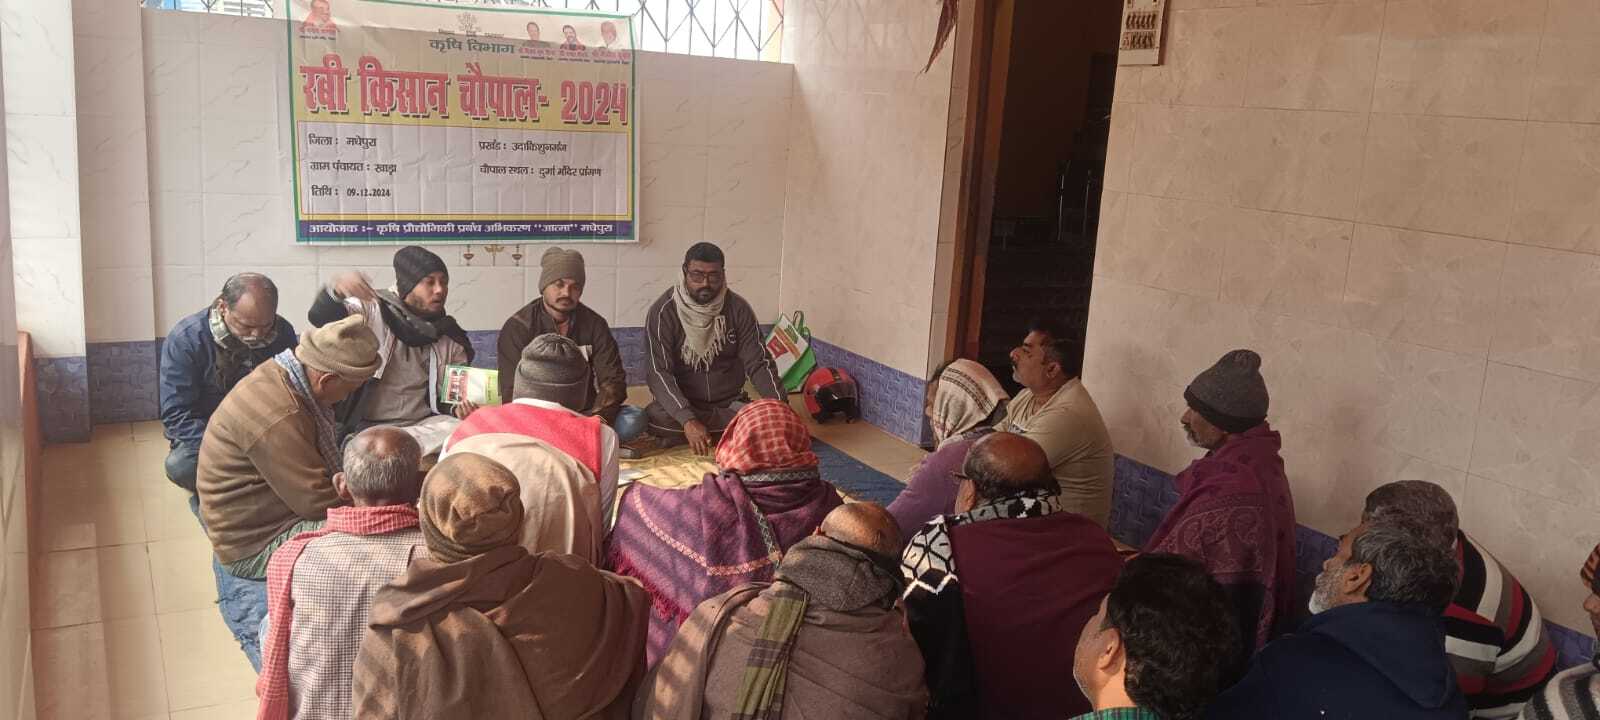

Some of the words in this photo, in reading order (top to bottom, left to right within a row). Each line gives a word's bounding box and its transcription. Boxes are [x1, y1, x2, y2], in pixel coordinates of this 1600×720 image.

[429, 37, 462, 53] कृषि
[466, 38, 515, 54] विभाग
[299, 53, 350, 115] रबी
[357, 55, 451, 119] किसान
[560, 79, 629, 126] 2024
[308, 133, 333, 146] जिला
[346, 135, 377, 149] मधेपुरा
[479, 139, 501, 151] प्रखंड
[512, 140, 567, 154] उदाकिशुनगंज
[310, 161, 330, 171] ग्राम
[332, 160, 364, 172] पंचायत
[480, 163, 507, 175] चौपाल
[311, 184, 333, 197] तिथि
[346, 188, 391, 198] 09.12.2024
[309, 223, 358, 233] आयोजक
[376, 222, 400, 235] कृषि
[484, 223, 531, 233] अभिकरण
[580, 224, 613, 234] मधेपुरा
